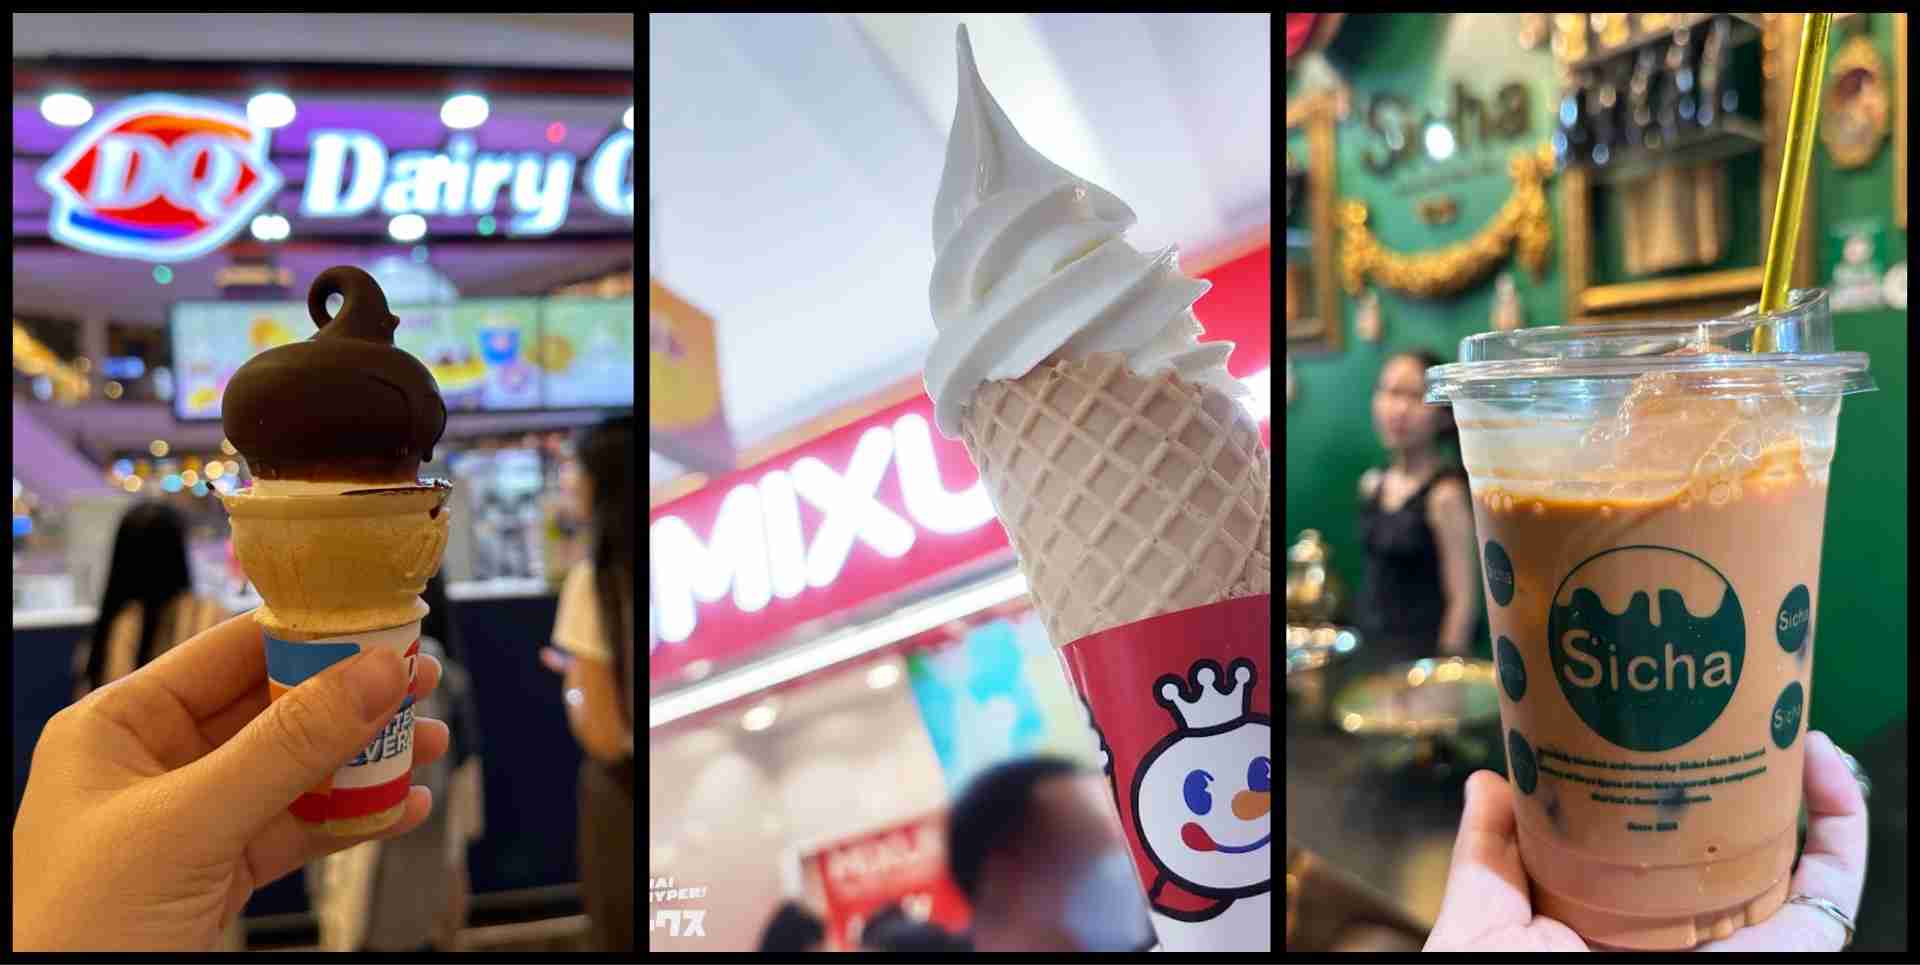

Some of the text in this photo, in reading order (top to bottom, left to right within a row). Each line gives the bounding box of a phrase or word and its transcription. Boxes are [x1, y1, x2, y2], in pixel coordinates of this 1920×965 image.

[92, 133, 242, 214] DQ
[303, 130, 575, 234] Dairy
[1561, 628, 1733, 692] Sicha
